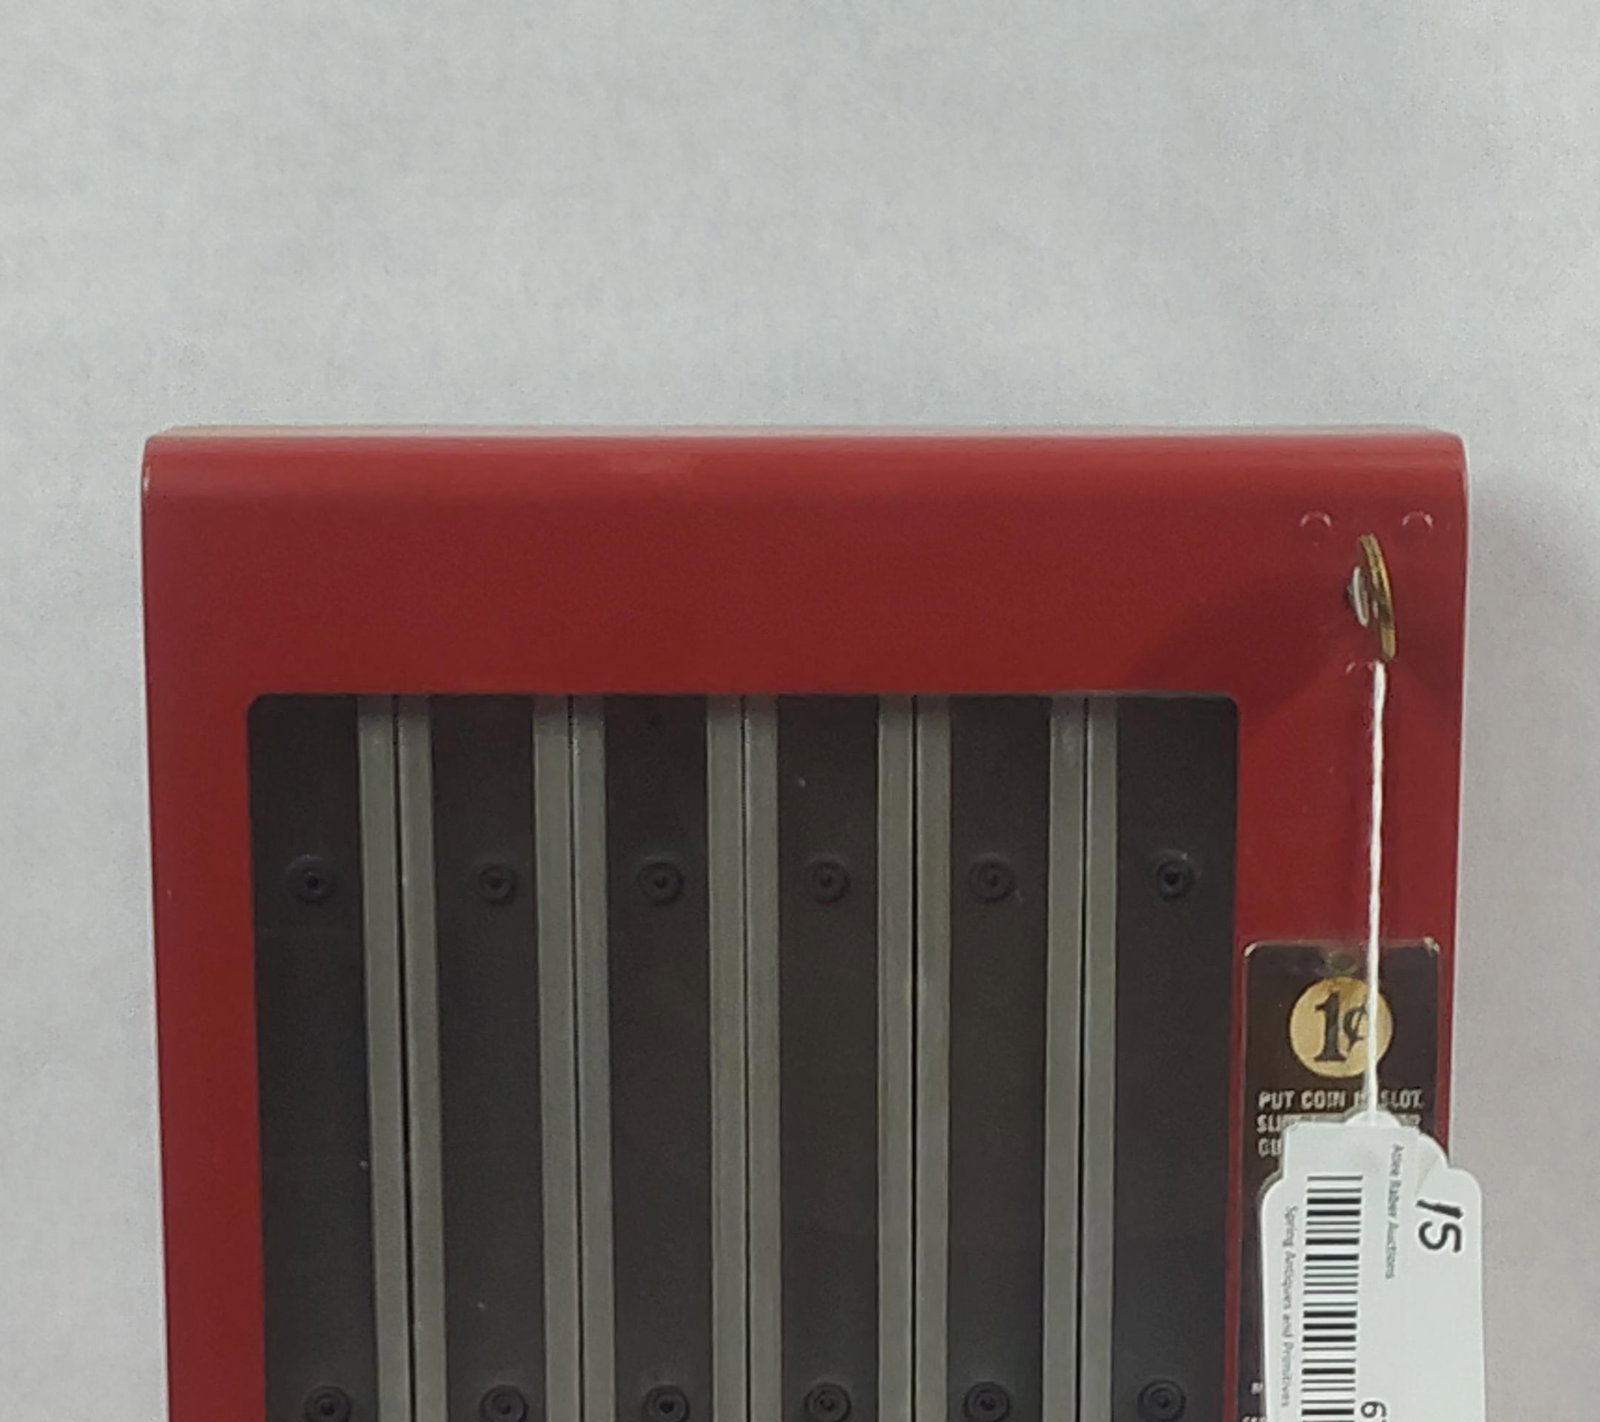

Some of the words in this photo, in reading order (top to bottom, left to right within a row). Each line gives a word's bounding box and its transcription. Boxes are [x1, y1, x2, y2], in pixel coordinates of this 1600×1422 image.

[1258, 1089, 1295, 1109] PUT
[1301, 1089, 1345, 1109] COIN
[1387, 1179, 1402, 1217] Raber
[1282, 1205, 1298, 1247] Spring
[1384, 1219, 1399, 1279] Auctions
[1281, 1250, 1296, 1309] Antiques
[1281, 1313, 1294, 1337] and
[1280, 1341, 1295, 1407] Primitives
